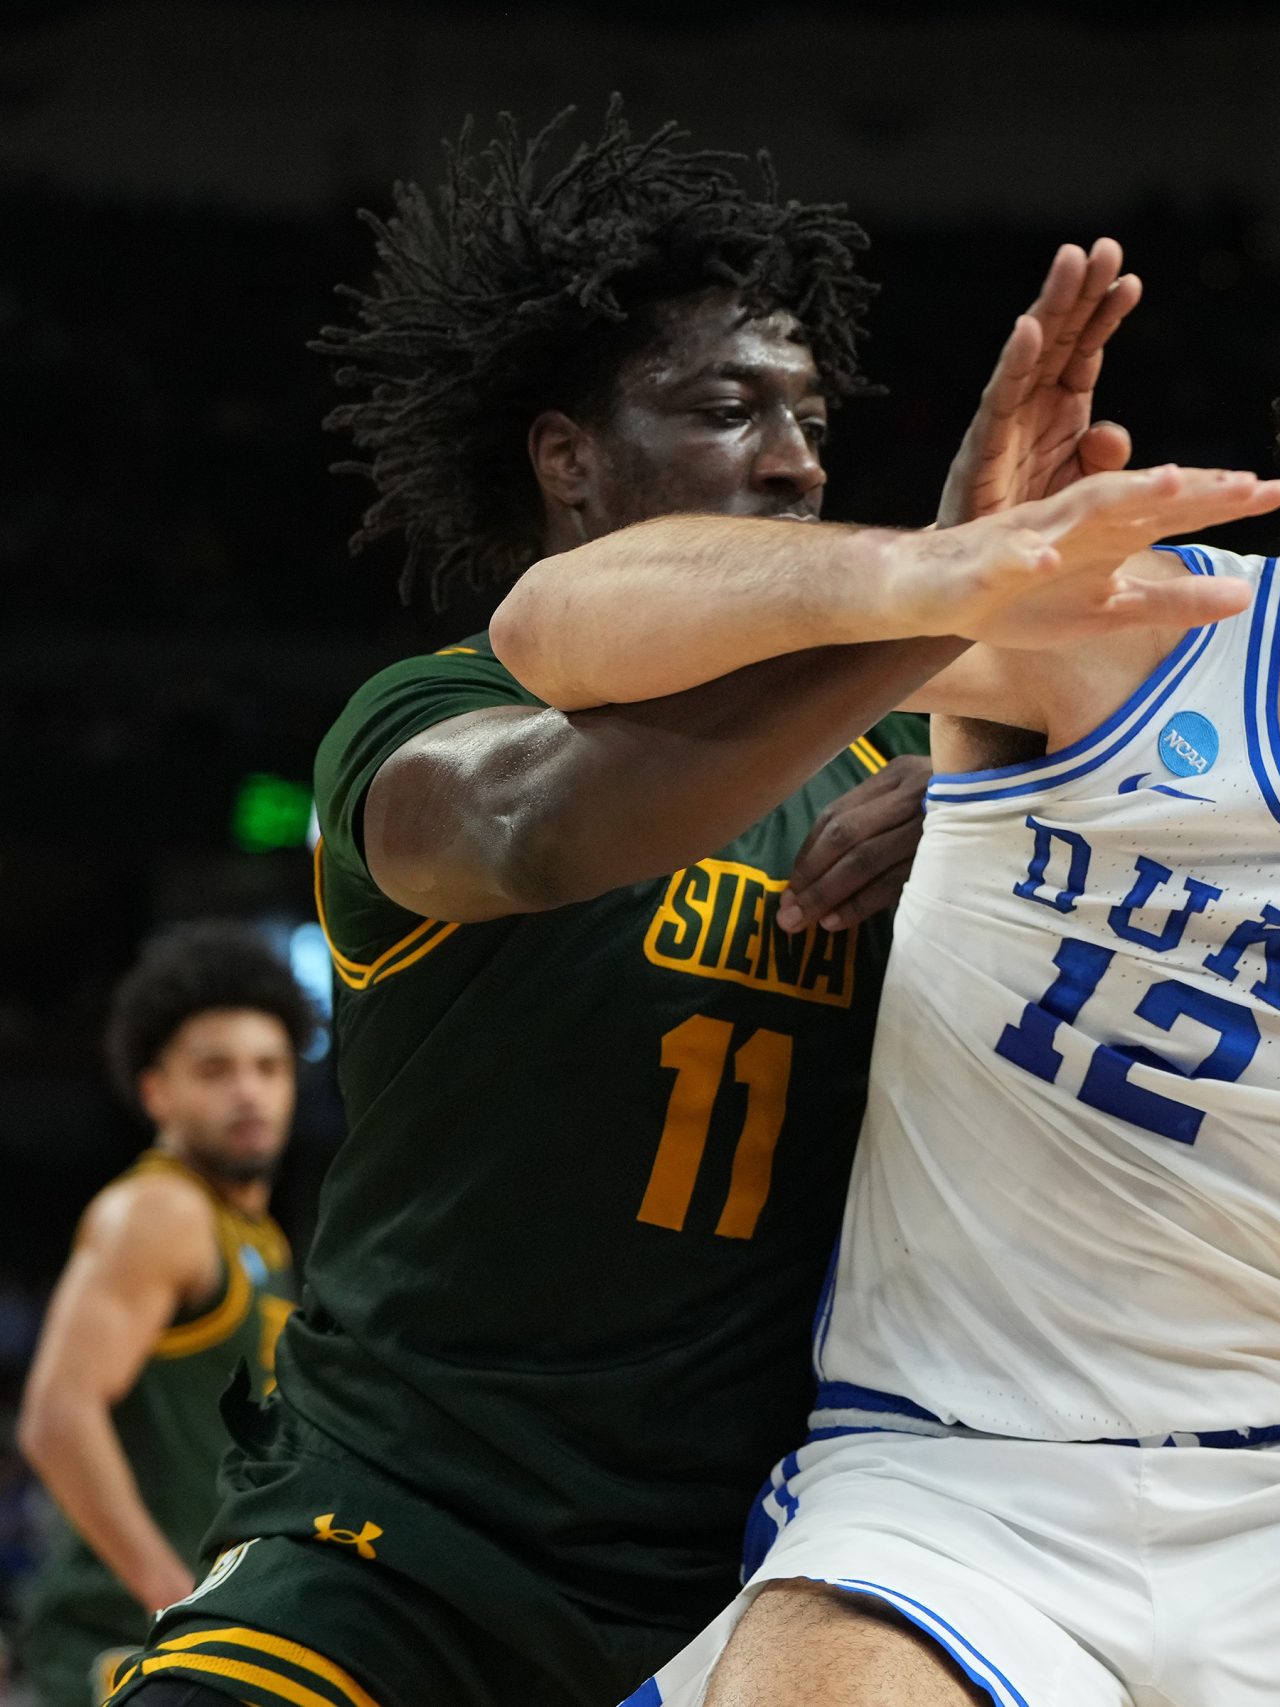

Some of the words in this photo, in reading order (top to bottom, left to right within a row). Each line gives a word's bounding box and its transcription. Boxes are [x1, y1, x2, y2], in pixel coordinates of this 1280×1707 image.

[1164, 729, 1208, 774] NCAA
[636, 1013, 793, 1240] 11
[995, 937, 1262, 1146] 12
